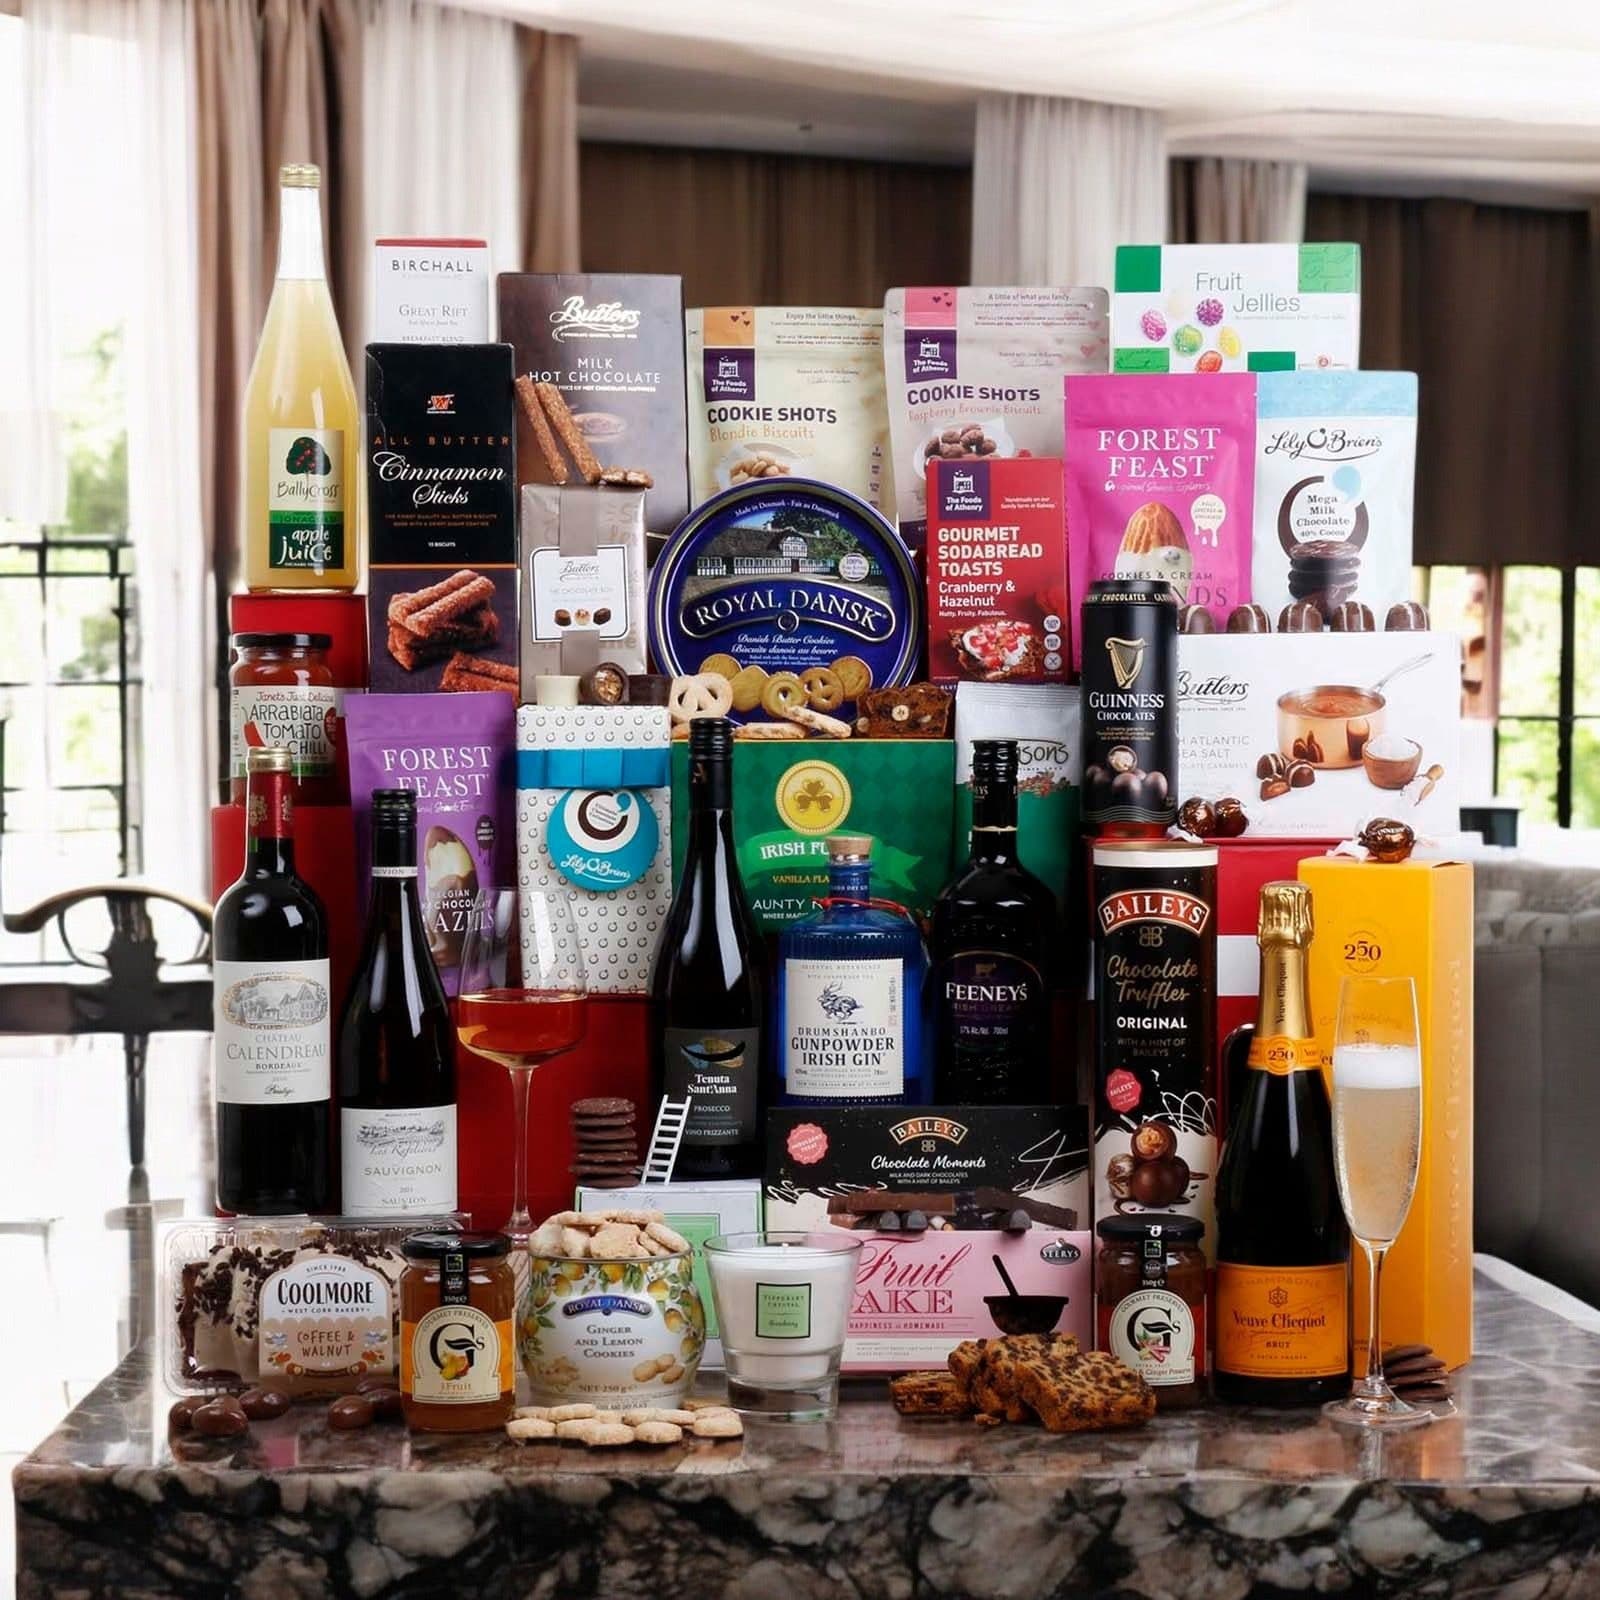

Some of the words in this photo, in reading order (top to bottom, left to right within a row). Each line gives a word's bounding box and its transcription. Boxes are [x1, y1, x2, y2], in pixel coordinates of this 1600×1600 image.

[392, 259, 473, 272] BIRCHALL
[1196, 272, 1242, 292] Fruit
[1233, 293, 1301, 314] Jellies
[549, 295, 641, 328] Butlers
[577, 358, 614, 369] MILK
[914, 359, 927, 367] The
[928, 359, 948, 367] Foods
[921, 366, 949, 374] Athenry
[529, 371, 561, 382] HOT
[568, 371, 662, 384] CHOCOLATE
[712, 379, 725, 387] The
[726, 379, 746, 388] Foods
[719, 386, 748, 394] Athenry
[907, 384, 974, 405] COOKIE
[978, 387, 1041, 402] SHOTS
[707, 406, 773, 424] COOKIE
[778, 407, 837, 424] SHOTS
[709, 424, 758, 442] Blondie
[763, 424, 815, 439] Biscuits
[1098, 428, 1221, 451] FOREST
[373, 436, 410, 446] ALL
[428, 436, 511, 446] BUTTER
[373, 451, 504, 481] Cinnamon
[1108, 456, 1209, 480] FEAST
[412, 482, 469, 509] Sticks
[961, 496, 982, 504] Foods
[1307, 495, 1338, 505] Mega
[759, 500, 786, 509] Denmark
[954, 504, 983, 512] Athenry
[1310, 506, 1336, 515] Milk
[1296, 517, 1351, 527] Chocolate
[291, 525, 330, 545] apple
[938, 526, 1020, 543] GOURMET
[938, 543, 1043, 560] SODABREAD
[938, 561, 1003, 577] TOASTS
[1102, 571, 1152, 580] COOKIES
[1170, 571, 1213, 580] CREAM
[939, 581, 1003, 595] Cranberry
[1005, 580, 1016, 592] &
[939, 595, 995, 608] Hazelnut
[1102, 593, 1146, 601] CHOCOLATES
[695, 589, 782, 626] ROYAL
[790, 589, 882, 632] DANSK
[738, 634, 769, 643] Danish
[772, 634, 801, 644] Butter
[803, 635, 835, 645] Cookies
[731, 643, 766, 653] Biscuits
[811, 645, 838, 655] beurre
[1177, 670, 1249, 697] Butlers
[1089, 691, 1165, 708] GUINNESS
[1097, 710, 1156, 721] CHOCOLATES
[1190, 736, 1250, 746] ATLANTIC
[381, 746, 493, 771] FOREST
[1200, 749, 1230, 759] SALT
[396, 774, 486, 798] FEAST
[760, 841, 805, 859] IRISH
[773, 875, 810, 883] VANILLA
[752, 899, 805, 910] AUNTY
[1102, 895, 1203, 925] BAILEYS
[1344, 940, 1381, 961] 250
[1106, 955, 1199, 979] Chocolate
[1116, 980, 1190, 1008] Truffles
[1116, 1016, 1188, 1030] ORIGINAL
[798, 1027, 886, 1037] DRUMSHANBO
[791, 1037, 895, 1051] GUNPOWDER
[226, 1043, 326, 1061] CALENDREAU
[1268, 1047, 1294, 1061] 250
[255, 1062, 302, 1070] BORDEAUX
[803, 1053, 846, 1066] IRISH
[852, 1053, 881, 1066] GIN
[694, 1073, 730, 1084] Tenuta
[687, 1084, 738, 1094] Sant'Anna
[703, 1128, 739, 1136] FRIZZANTE
[896, 1121, 961, 1140] BAILEYS
[871, 1155, 930, 1170] Chocolate
[933, 1155, 986, 1169] Moments
[364, 1164, 441, 1177] SAUVIGNON
[306, 1264, 327, 1273] SINCE
[278, 1278, 376, 1305] COOLMORE
[567, 1299, 605, 1314] ROYAL
[610, 1299, 646, 1313] DANSK
[853, 1289, 953, 1314] AKE
[1120, 1294, 1150, 1314] GOURMET
[1152, 1294, 1185, 1314] PRESERVES
[1232, 1311, 1268, 1328] Veuve
[1271, 1312, 1326, 1332] Clicquot
[586, 1324, 632, 1335] GINGER
[575, 1338, 599, 1347] AND
[602, 1337, 643, 1347] LEMON
[302, 1344, 353, 1358] WALNUT
[583, 1348, 636, 1359] COOKIES
[579, 1384, 599, 1392] NET
[602, 1384, 620, 1392] 250
